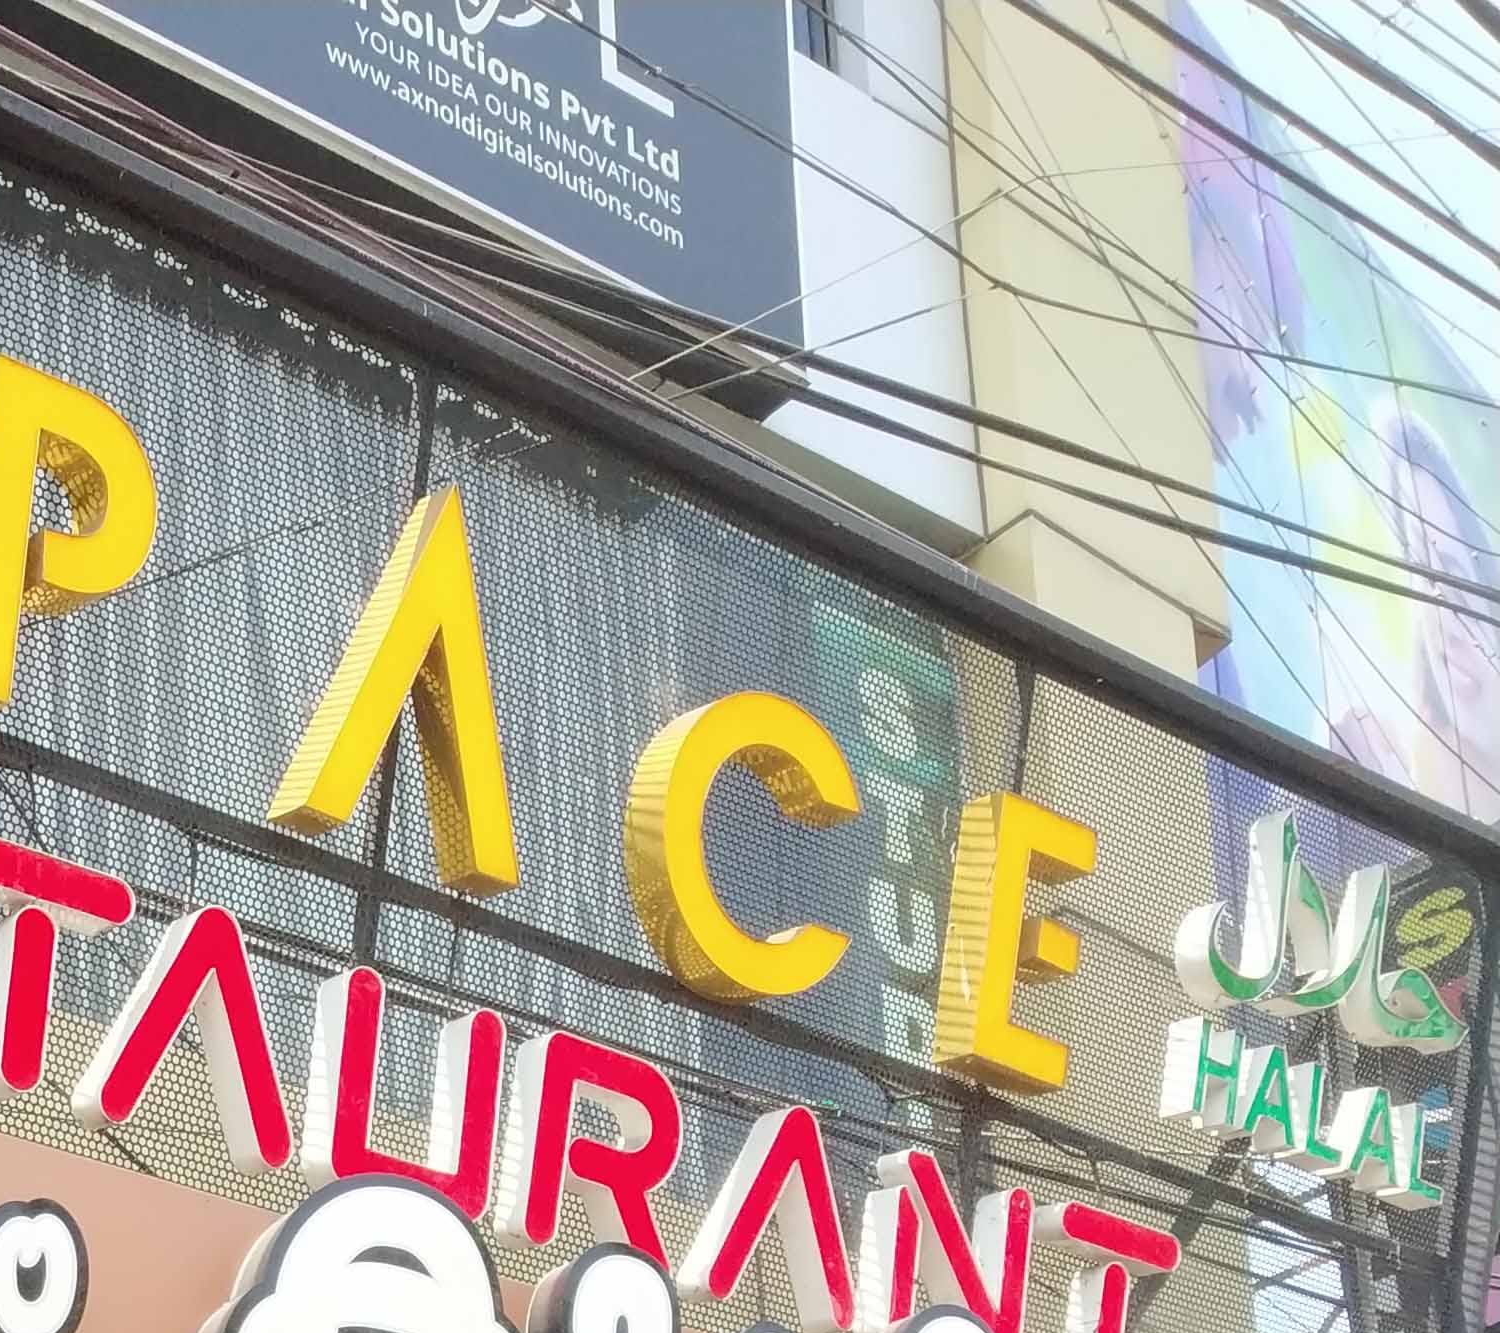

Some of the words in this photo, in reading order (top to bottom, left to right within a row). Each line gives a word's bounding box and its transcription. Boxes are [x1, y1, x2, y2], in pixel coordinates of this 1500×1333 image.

[325, 41, 685, 250] www.axnoldigitalsolutions.com
[355, 20, 421, 75] YOUR
[427, 60, 479, 106] IDEA
[485, 93, 533, 136] OUR
[539, 120, 683, 217] INNOVATIONS
[380, 0, 550, 110] Solutions
[561, 88, 616, 148] Pvt
[627, 125, 680, 183] Ltd
[1164, 1016, 1444, 1210] HALAL
